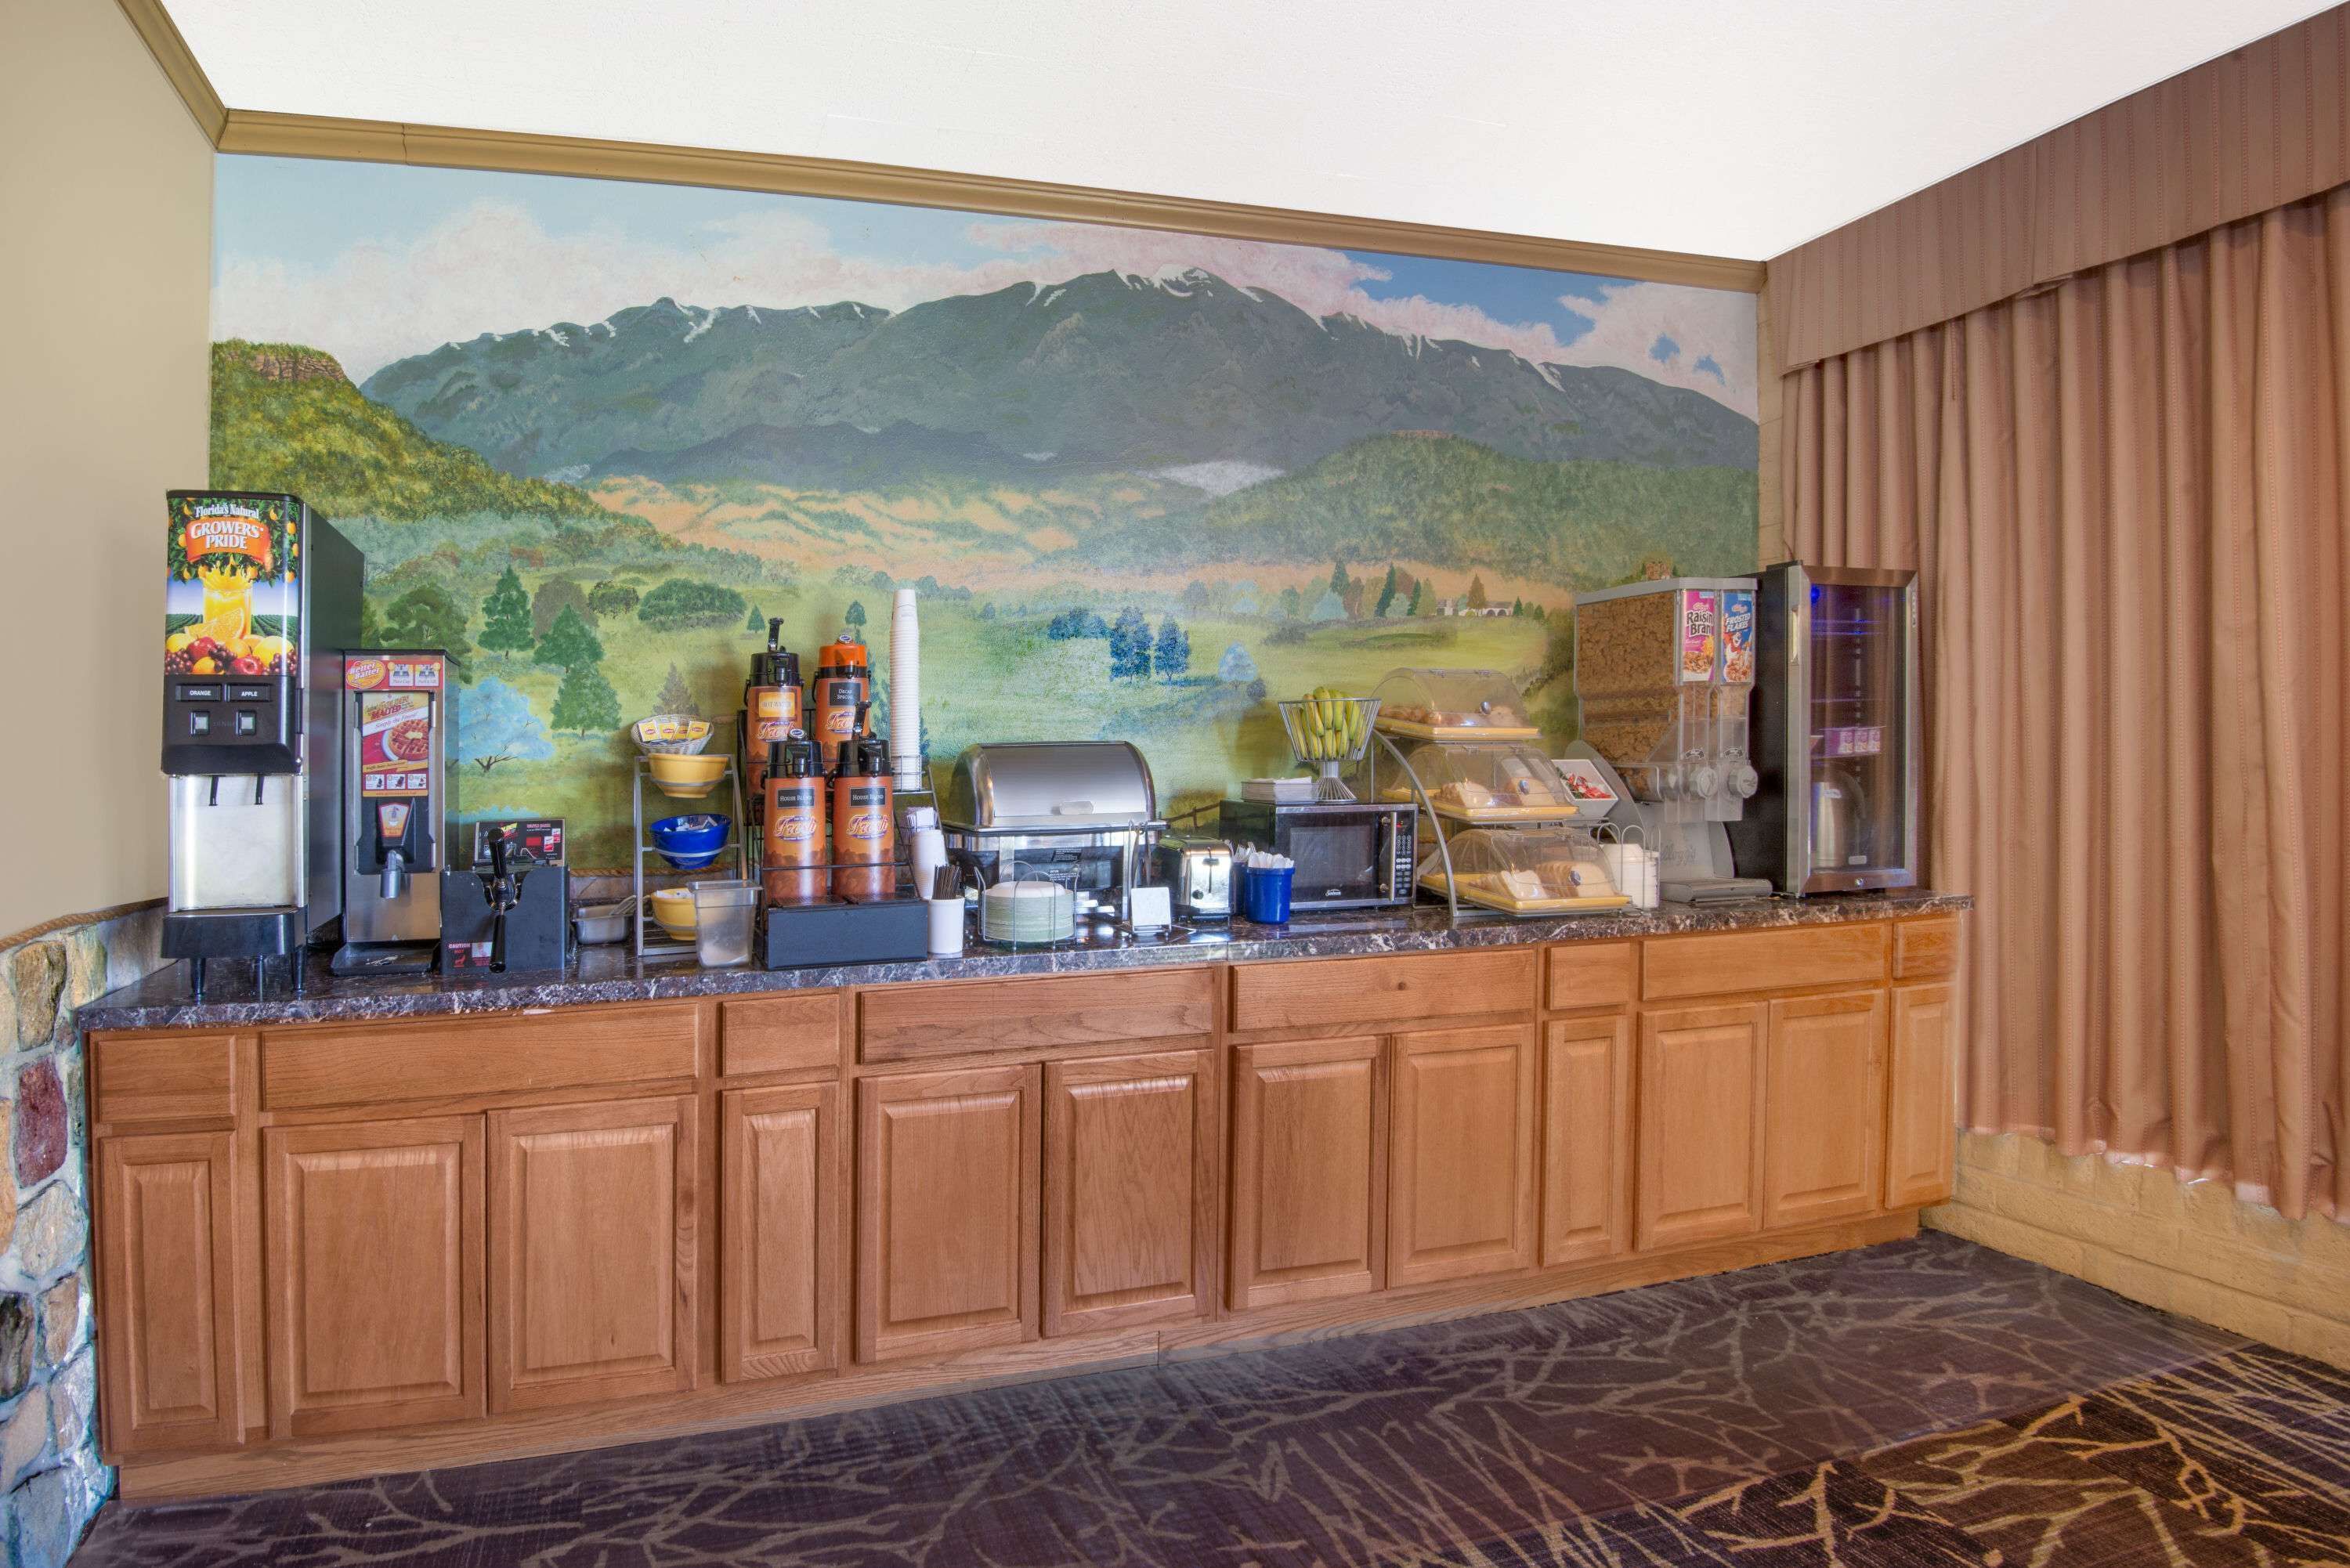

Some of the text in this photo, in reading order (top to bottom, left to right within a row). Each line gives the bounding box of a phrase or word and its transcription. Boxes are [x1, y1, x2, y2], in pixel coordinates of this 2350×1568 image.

[195, 502, 259, 518] Florida's Natural
[205, 534, 248, 549] PRIDE
[1686, 610, 1714, 625] Raisin
[1726, 612, 1751, 627] FROSTED
[1690, 623, 1712, 637] Bran
[773, 815, 817, 837] Fresh
[847, 815, 888, 836] Fresh
